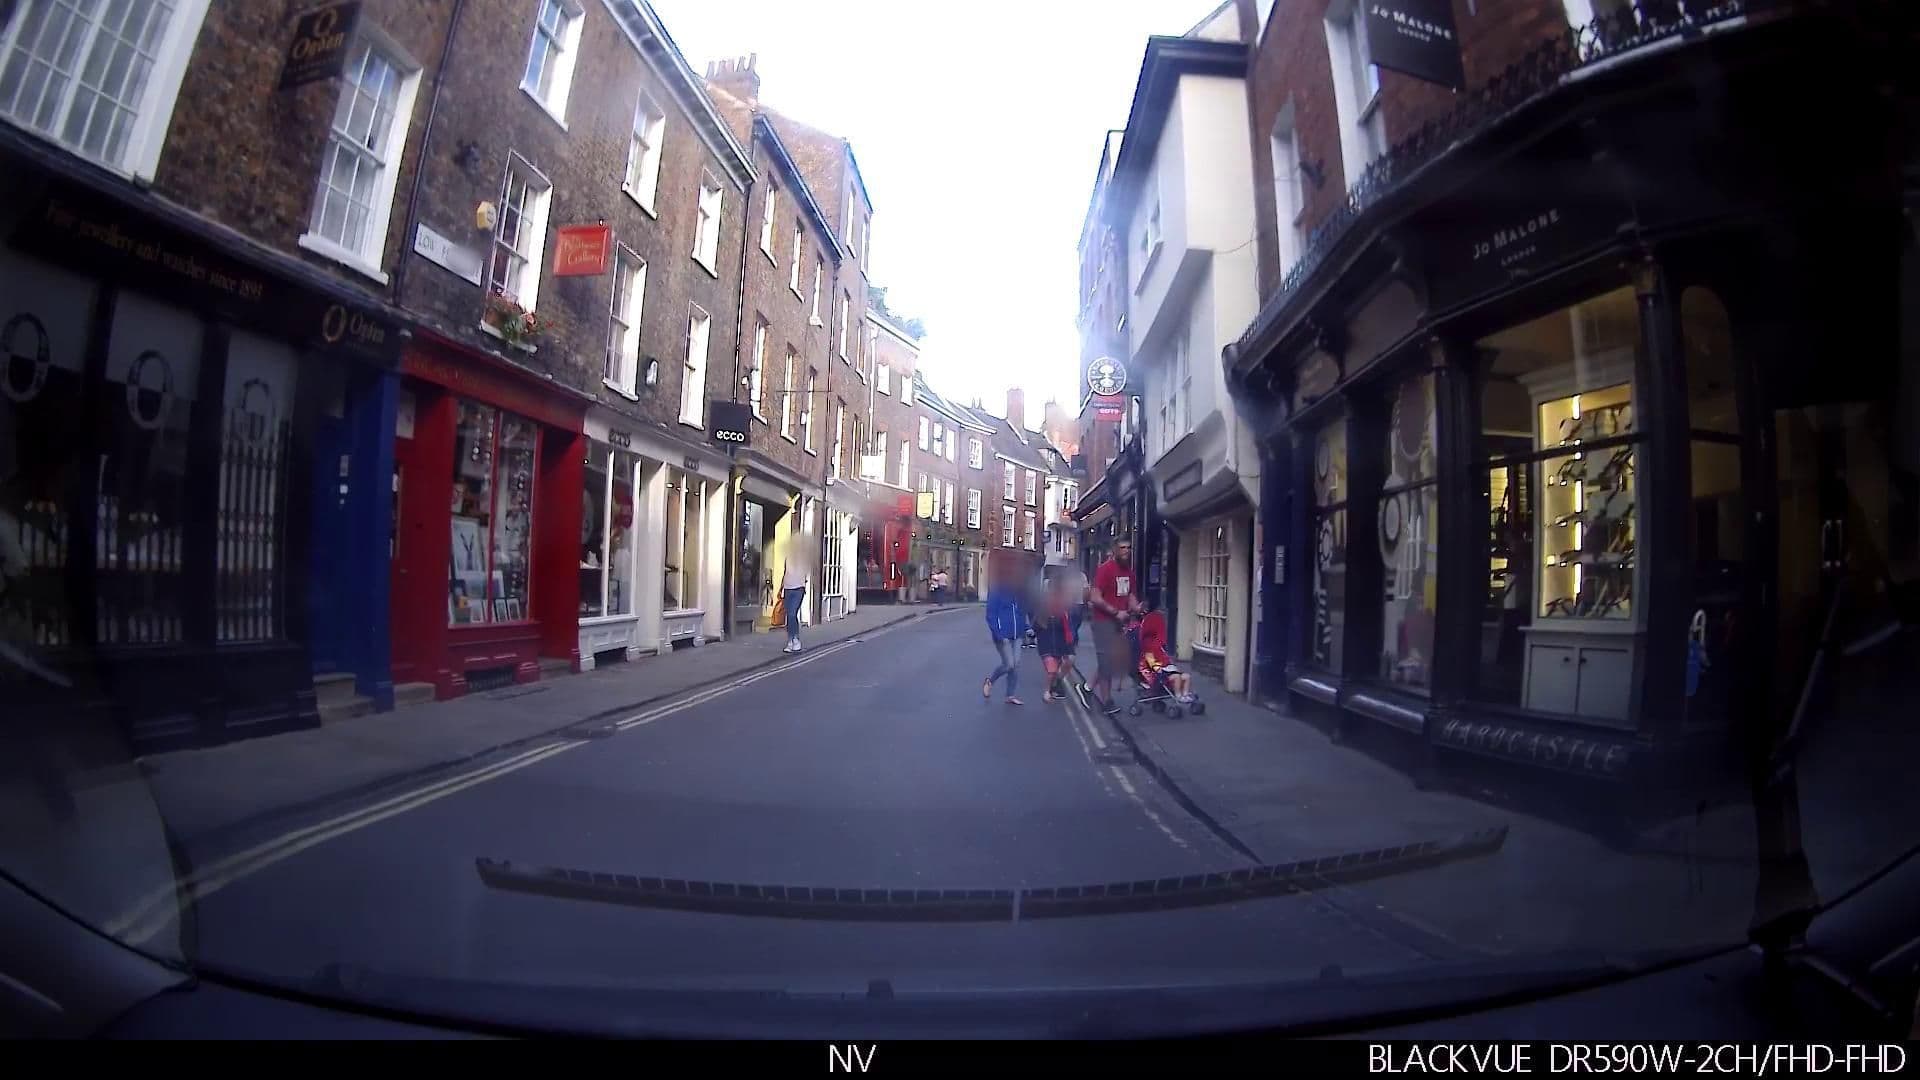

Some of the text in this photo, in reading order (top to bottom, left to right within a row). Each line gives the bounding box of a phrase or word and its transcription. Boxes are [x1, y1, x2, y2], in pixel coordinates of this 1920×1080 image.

[1370, 4, 1453, 41] JO MALONE
[1473, 208, 1560, 260] JO MALONE
[716, 430, 745, 442] ecco
[1442, 719, 1625, 772] HARDCASTLE
